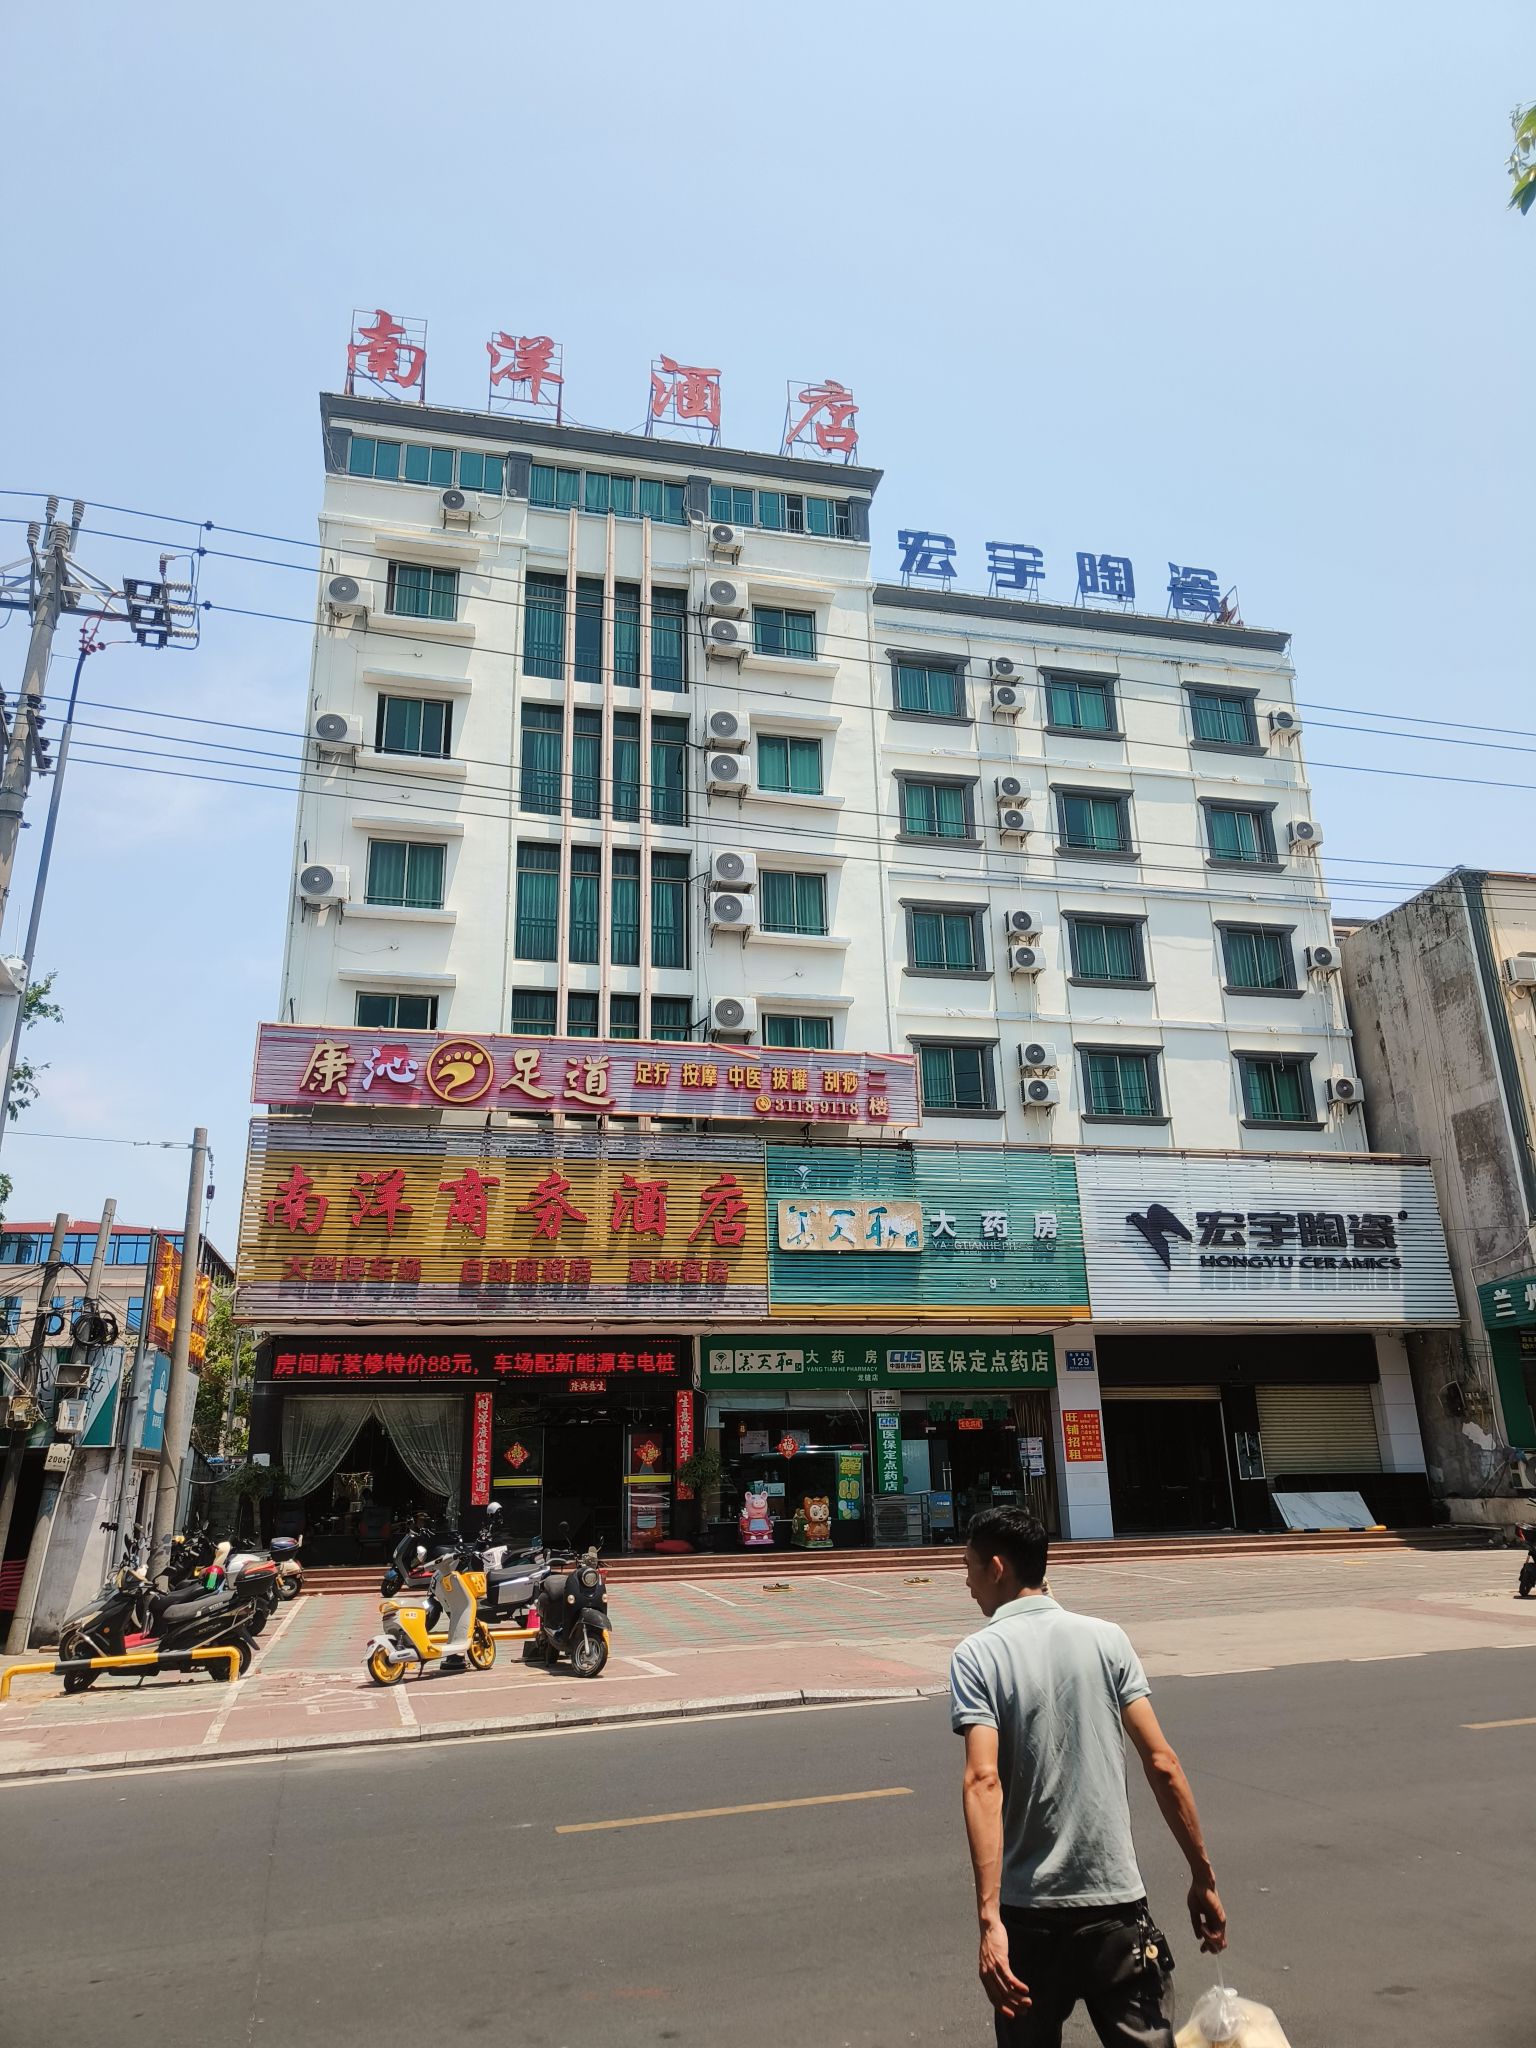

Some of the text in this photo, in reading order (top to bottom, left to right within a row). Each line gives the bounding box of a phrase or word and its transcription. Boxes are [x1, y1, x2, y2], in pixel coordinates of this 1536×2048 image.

[348, 309, 858, 452] 南洋酒店
[898, 530, 1223, 613] 宏宇陶瓷
[500, 1048, 614, 1106] 足道
[635, 1062, 859, 1094] 足疗 按摩 中医 拔罐 刮痧
[774, 1098, 859, 1115] 3118 9118
[267, 1164, 750, 1246] 南洋商务酒店
[930, 1209, 1058, 1240] 大药房
[1197, 1211, 1398, 1249] 宏宇陶瓷
[284, 1256, 729, 1284] 大型停车场 自动麻将房 豪华客房
[1199, 1255, 1402, 1270] HONGYU CERAMICS
[805, 1350, 878, 1364] 大药房
[889, 1351, 922, 1363] CHS
[928, 1350, 1049, 1374] 医保定点药店
[1071, 1357, 1090, 1366] 129
[1065, 1412, 1082, 1460] 旺铺招租
[882, 1429, 898, 1491] 医保定点药店
